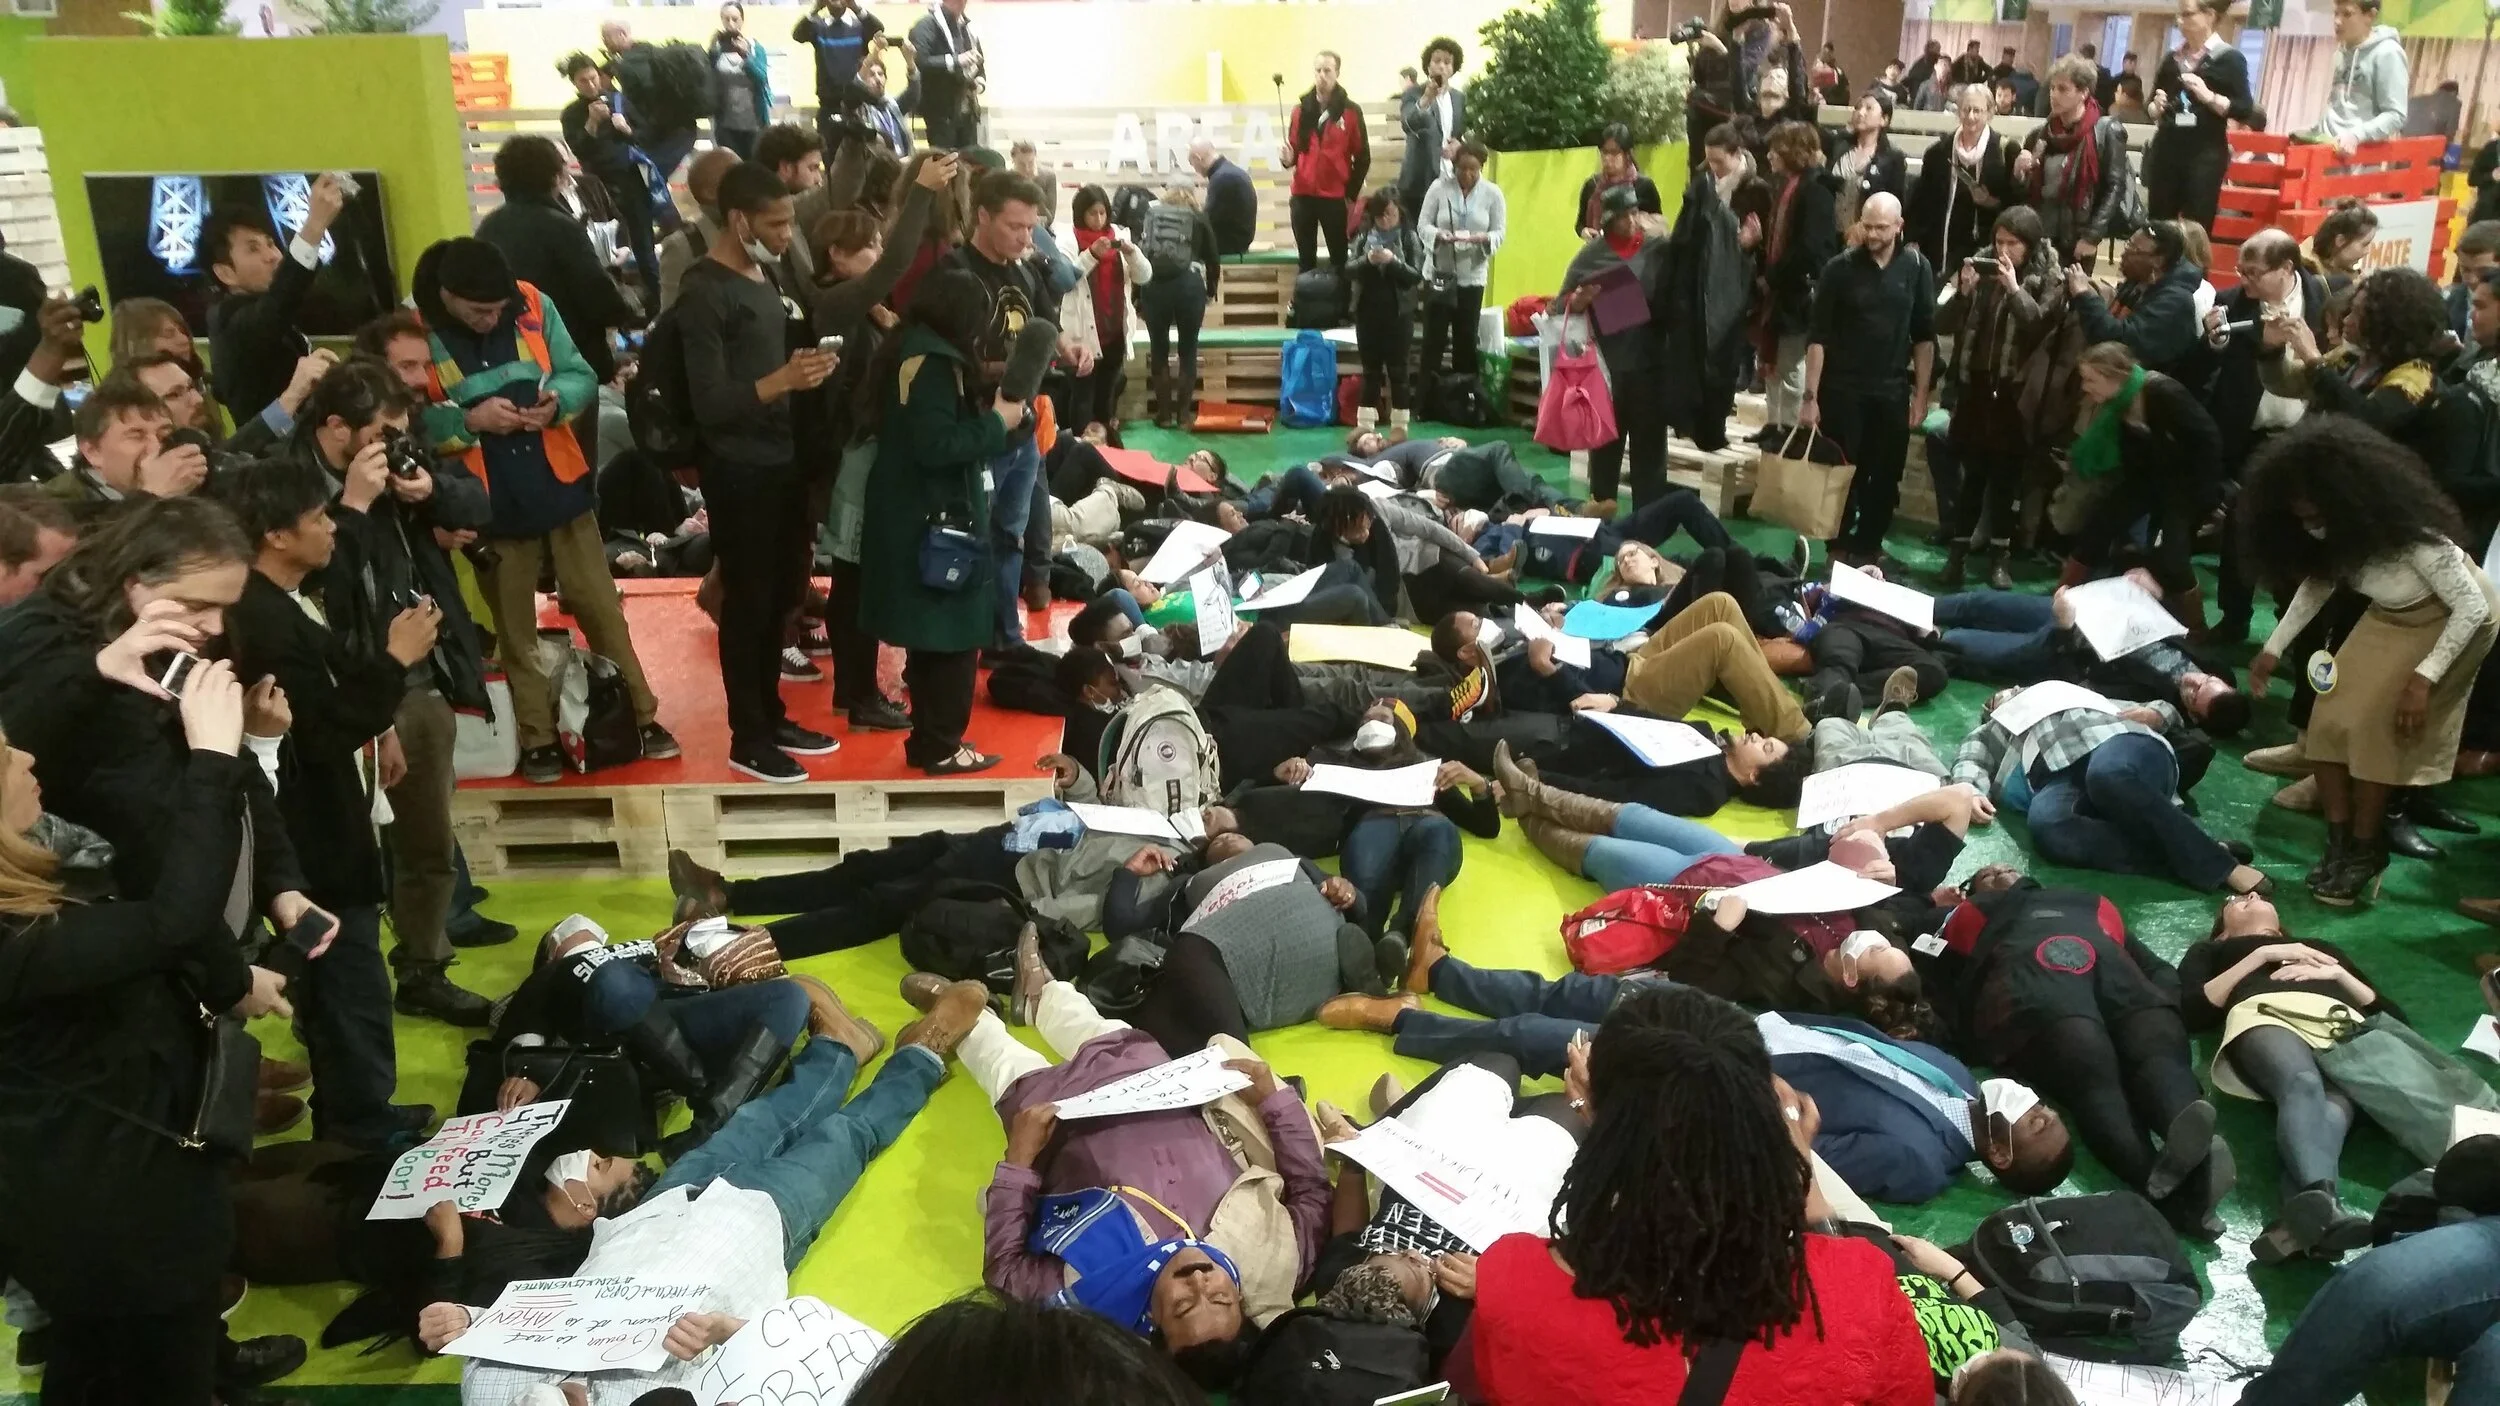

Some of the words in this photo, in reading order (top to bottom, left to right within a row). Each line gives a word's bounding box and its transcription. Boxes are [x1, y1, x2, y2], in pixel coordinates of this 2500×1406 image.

[1106, 109, 1282, 175] AREA
[422, 1147, 469, 1192] Feed
[454, 1150, 492, 1189] But
[459, 1153, 521, 1210] Money
[503, 1332, 550, 1344] not
[564, 1317, 583, 1331] is
[554, 1335, 577, 1350] is
[587, 1328, 657, 1362] Power
